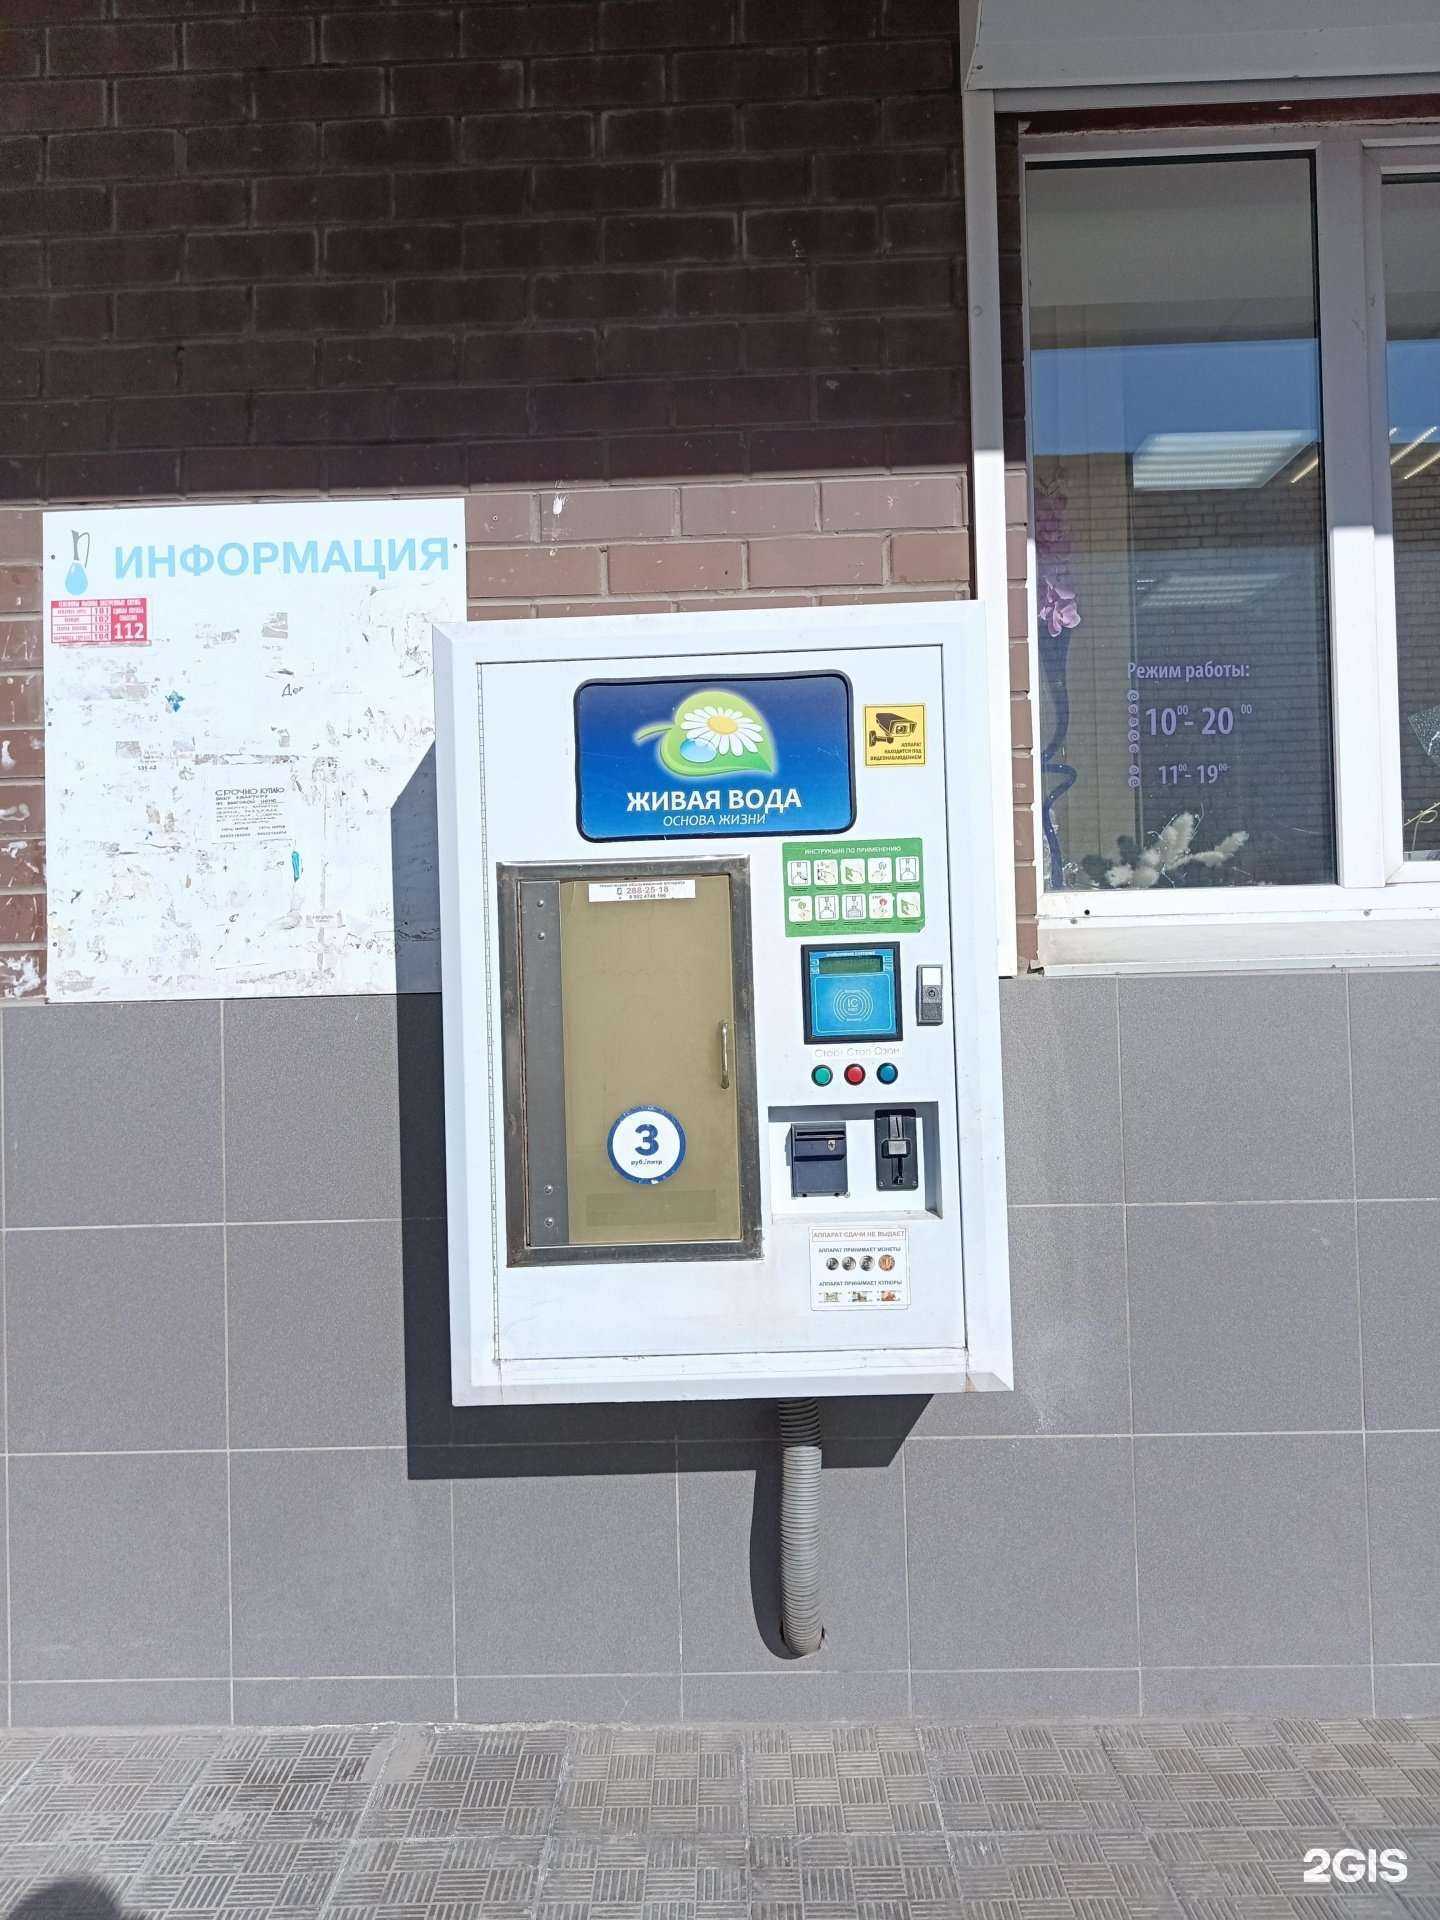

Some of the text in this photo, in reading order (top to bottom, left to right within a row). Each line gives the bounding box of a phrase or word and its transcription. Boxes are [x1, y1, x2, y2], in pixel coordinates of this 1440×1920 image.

[115, 537, 449, 580] ИНФОРМАЦИЯ
[114, 622, 145, 639] 112
[1128, 661, 1250, 682] Режим работы:
[626, 788, 802, 814] ЖИВАЯ ВОДА
[663, 814, 766, 827] ОСНОВА ЖИЗНИ
[856, 846, 902, 854] ПРИМЕНЕНИЮ
[635, 1124, 659, 1156] 3
